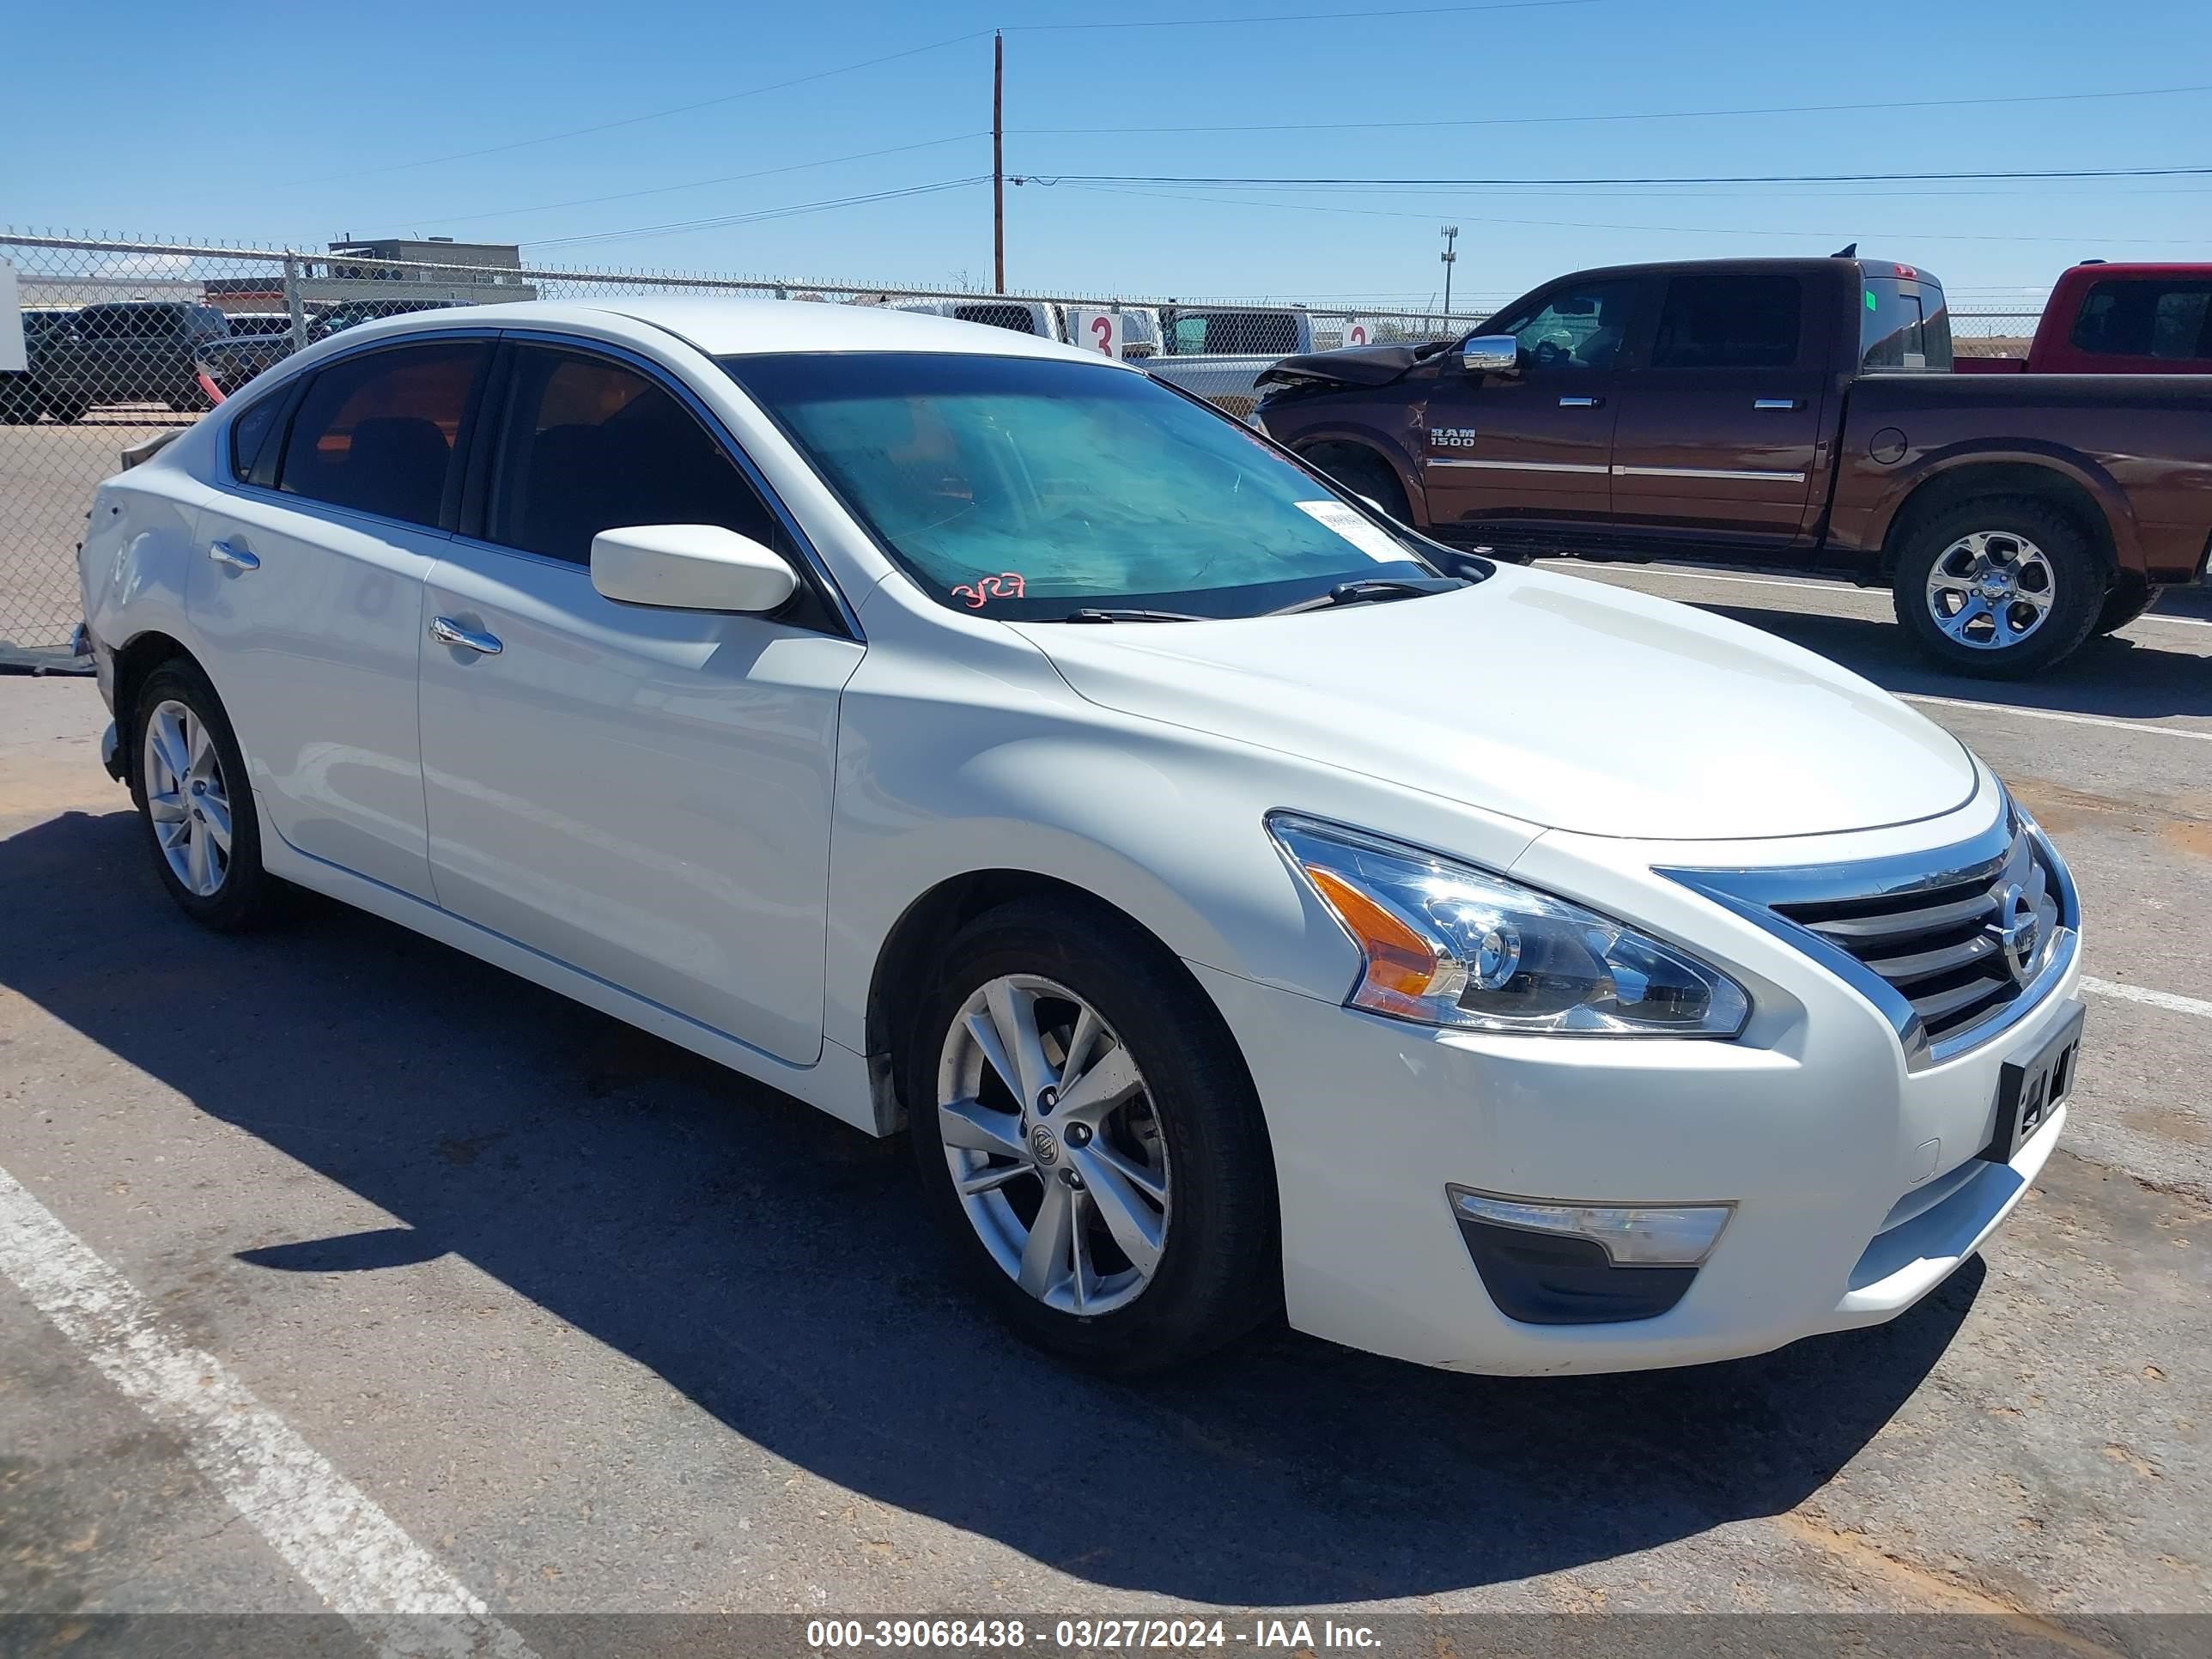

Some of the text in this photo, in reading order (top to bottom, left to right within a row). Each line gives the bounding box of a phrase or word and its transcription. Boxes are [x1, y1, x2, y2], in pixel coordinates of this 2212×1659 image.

[1091, 316, 1112, 357] 3
[1431, 428, 1476, 438] RAM
[1431, 437, 1475, 447] 1500
[951, 571, 1024, 609] 3/27
